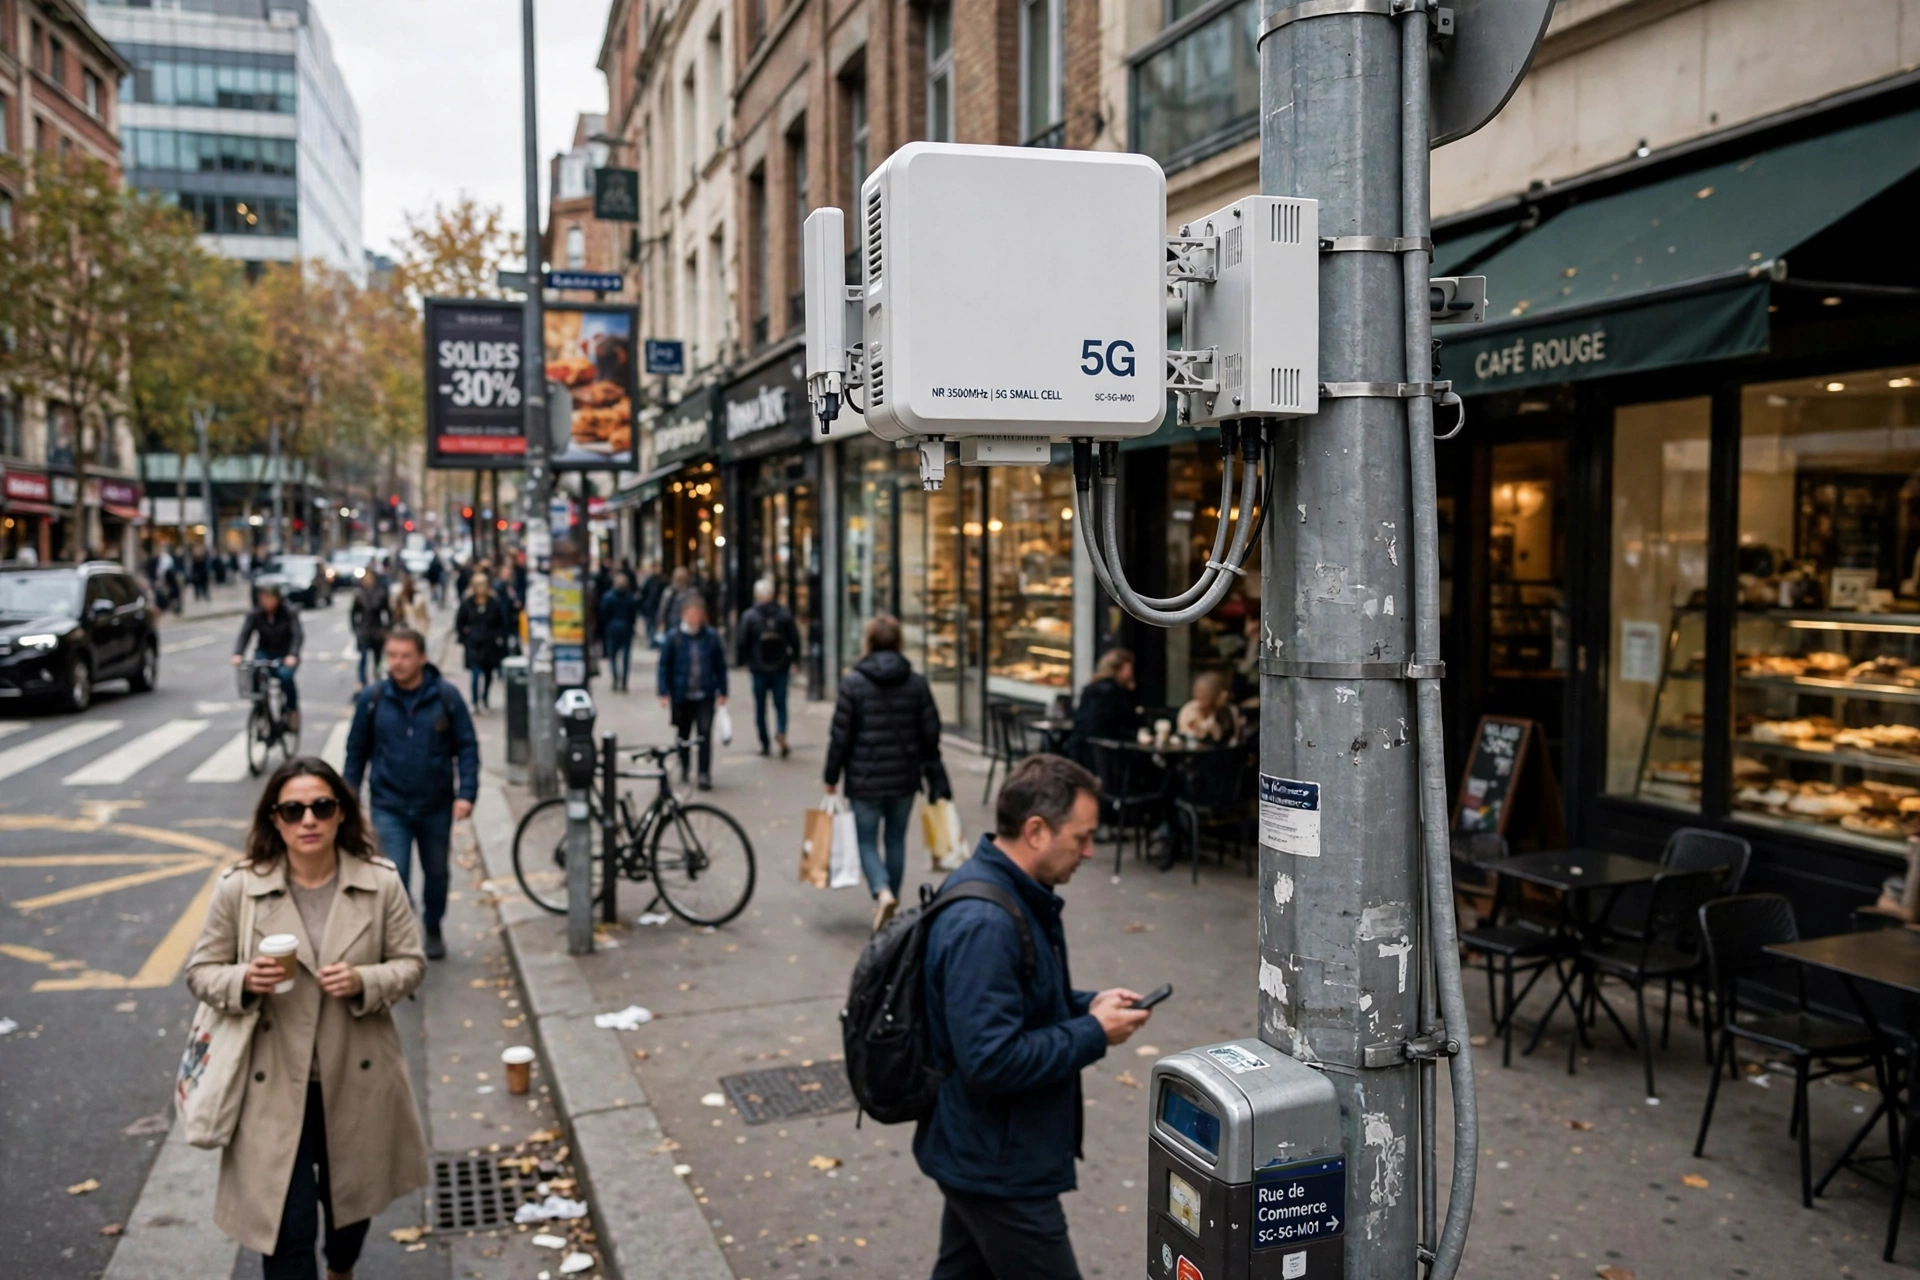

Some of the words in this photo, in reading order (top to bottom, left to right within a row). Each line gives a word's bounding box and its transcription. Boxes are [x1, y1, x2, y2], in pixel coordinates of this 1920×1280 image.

[438, 340, 520, 369] SOLDES
[1081, 339, 1135, 377] 5G
[1475, 337, 1526, 379] CAFÉ
[1531, 330, 1606, 371] ROUGE
[438, 370, 521, 407] -30%
[931, 387, 945, 398] NR
[947, 387, 988, 399] 3500MHz
[995, 389, 1008, 399] 5G
[1009, 389, 1039, 400] SMALL
[1040, 390, 1062, 400] CELL
[1094, 393, 1135, 402] SC-5G-M01
[1258, 1188, 1284, 1202] Rue
[1288, 1182, 1305, 1198] de
[1258, 1202, 1327, 1222] Commerce
[1258, 1221, 1319, 1242] SC-5G-M01
